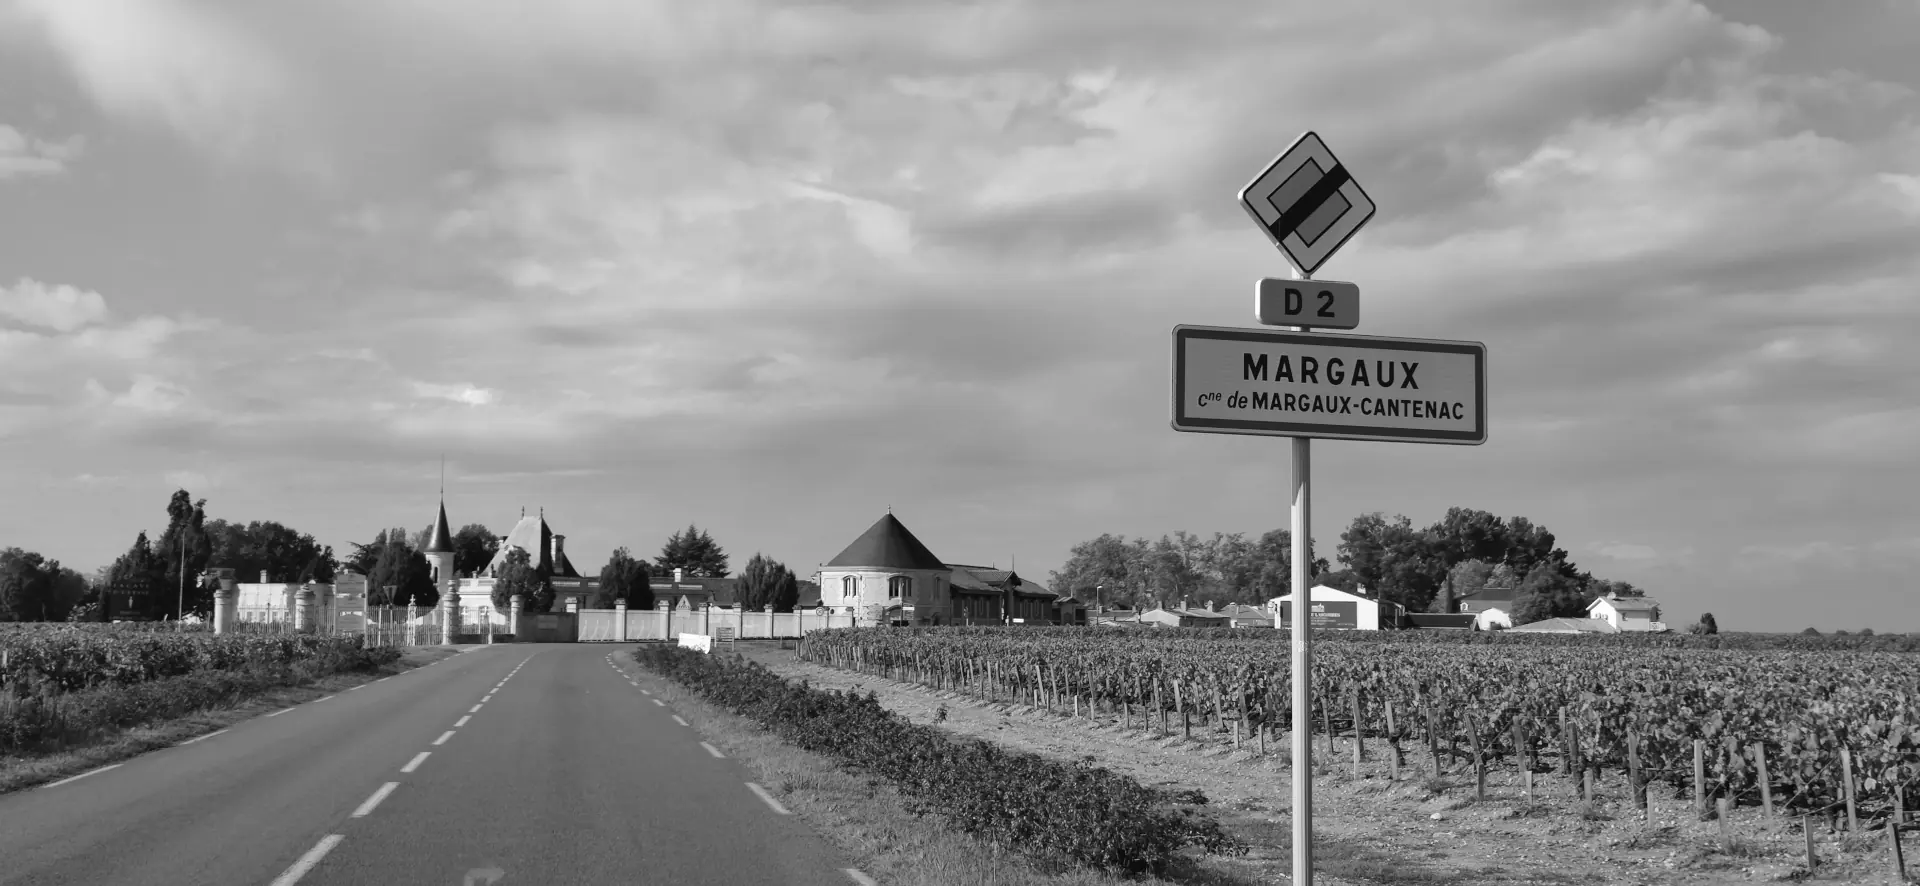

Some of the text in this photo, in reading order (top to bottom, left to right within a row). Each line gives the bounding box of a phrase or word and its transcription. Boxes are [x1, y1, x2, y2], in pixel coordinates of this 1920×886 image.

[1284, 288, 1335, 317] D 2
[1243, 353, 1419, 389] MARGAUX
[1227, 391, 1248, 409] de
[1252, 392, 1464, 420] MARGAUX-CANTENAC
